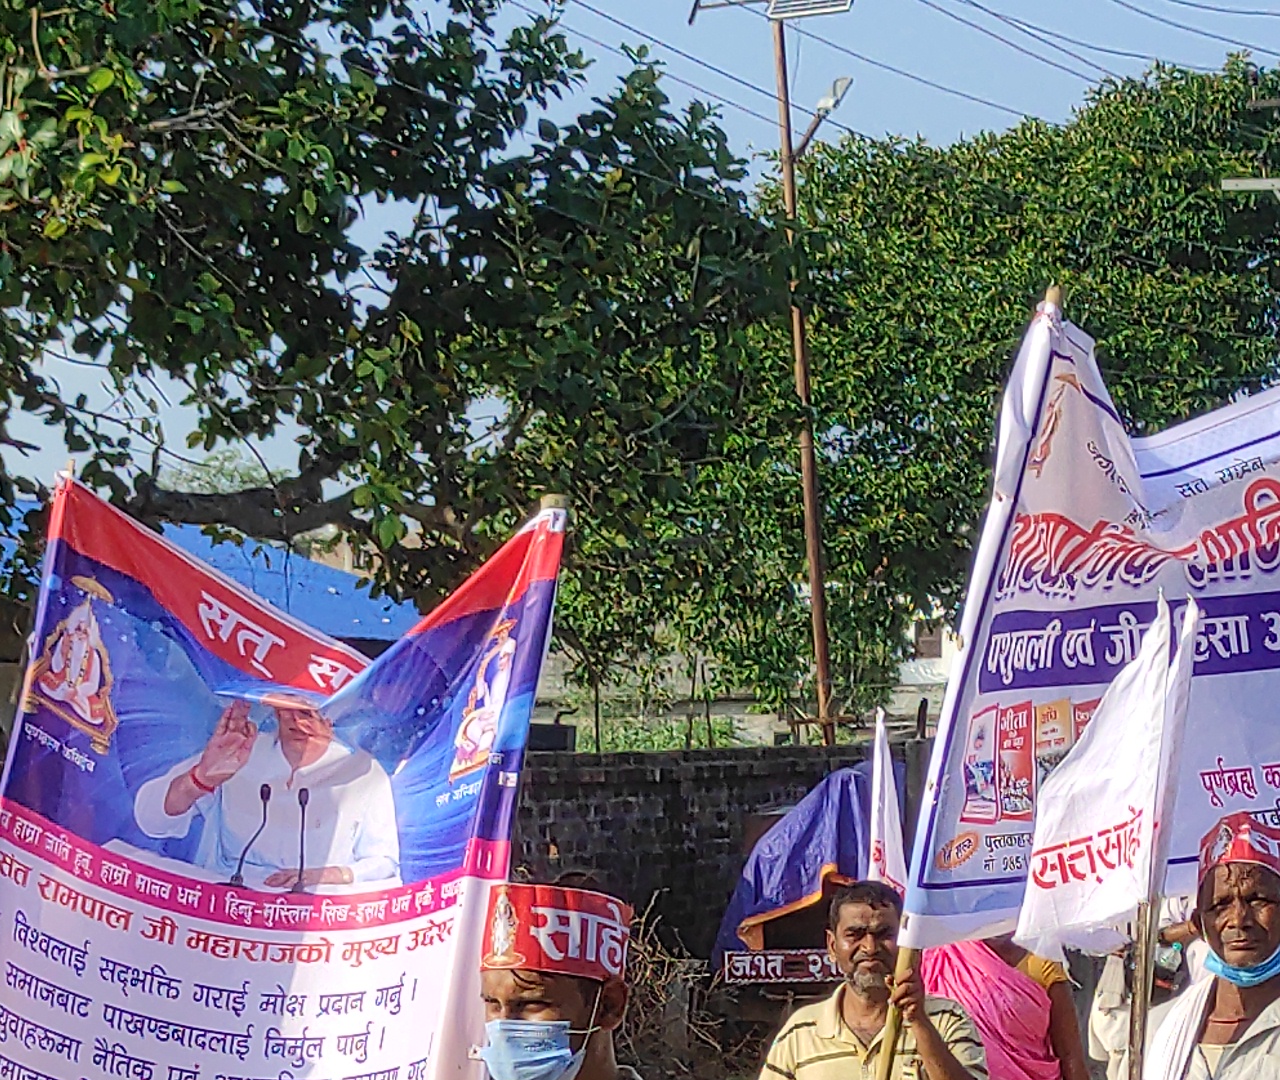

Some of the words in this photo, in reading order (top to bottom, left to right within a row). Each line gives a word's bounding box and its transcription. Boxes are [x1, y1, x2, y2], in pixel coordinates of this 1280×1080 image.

[197, 590, 286, 680] सत्
[307, 653, 362, 690] स
[986, 618, 1063, 685] पशुबली
[1063, 619, 1098, 669] एवं
[1099, 610, 1152, 666] जी
[1097, 806, 1145, 870] साहे
[37, 872, 135, 933] रामपाल
[140, 915, 180, 946] जी
[185, 926, 334, 964] महाराजको
[341, 934, 402, 968] मुख्य
[135, 872, 172, 900] मानव
[13, 909, 90, 977] विश्वलाई
[99, 957, 183, 999] सद्भक्ति
[193, 982, 249, 1018] गराई
[260, 983, 307, 1018] मोक्ष
[317, 991, 368, 1018] प्रदान
[376, 971, 407, 1016] गर्नु
[530, 903, 630, 976] साहे
[6, 961, 93, 1019] समाजबाट
[103, 1002, 254, 1062] पाखण्डबादलाई
[337, 1020, 374, 1064] पार्नु
